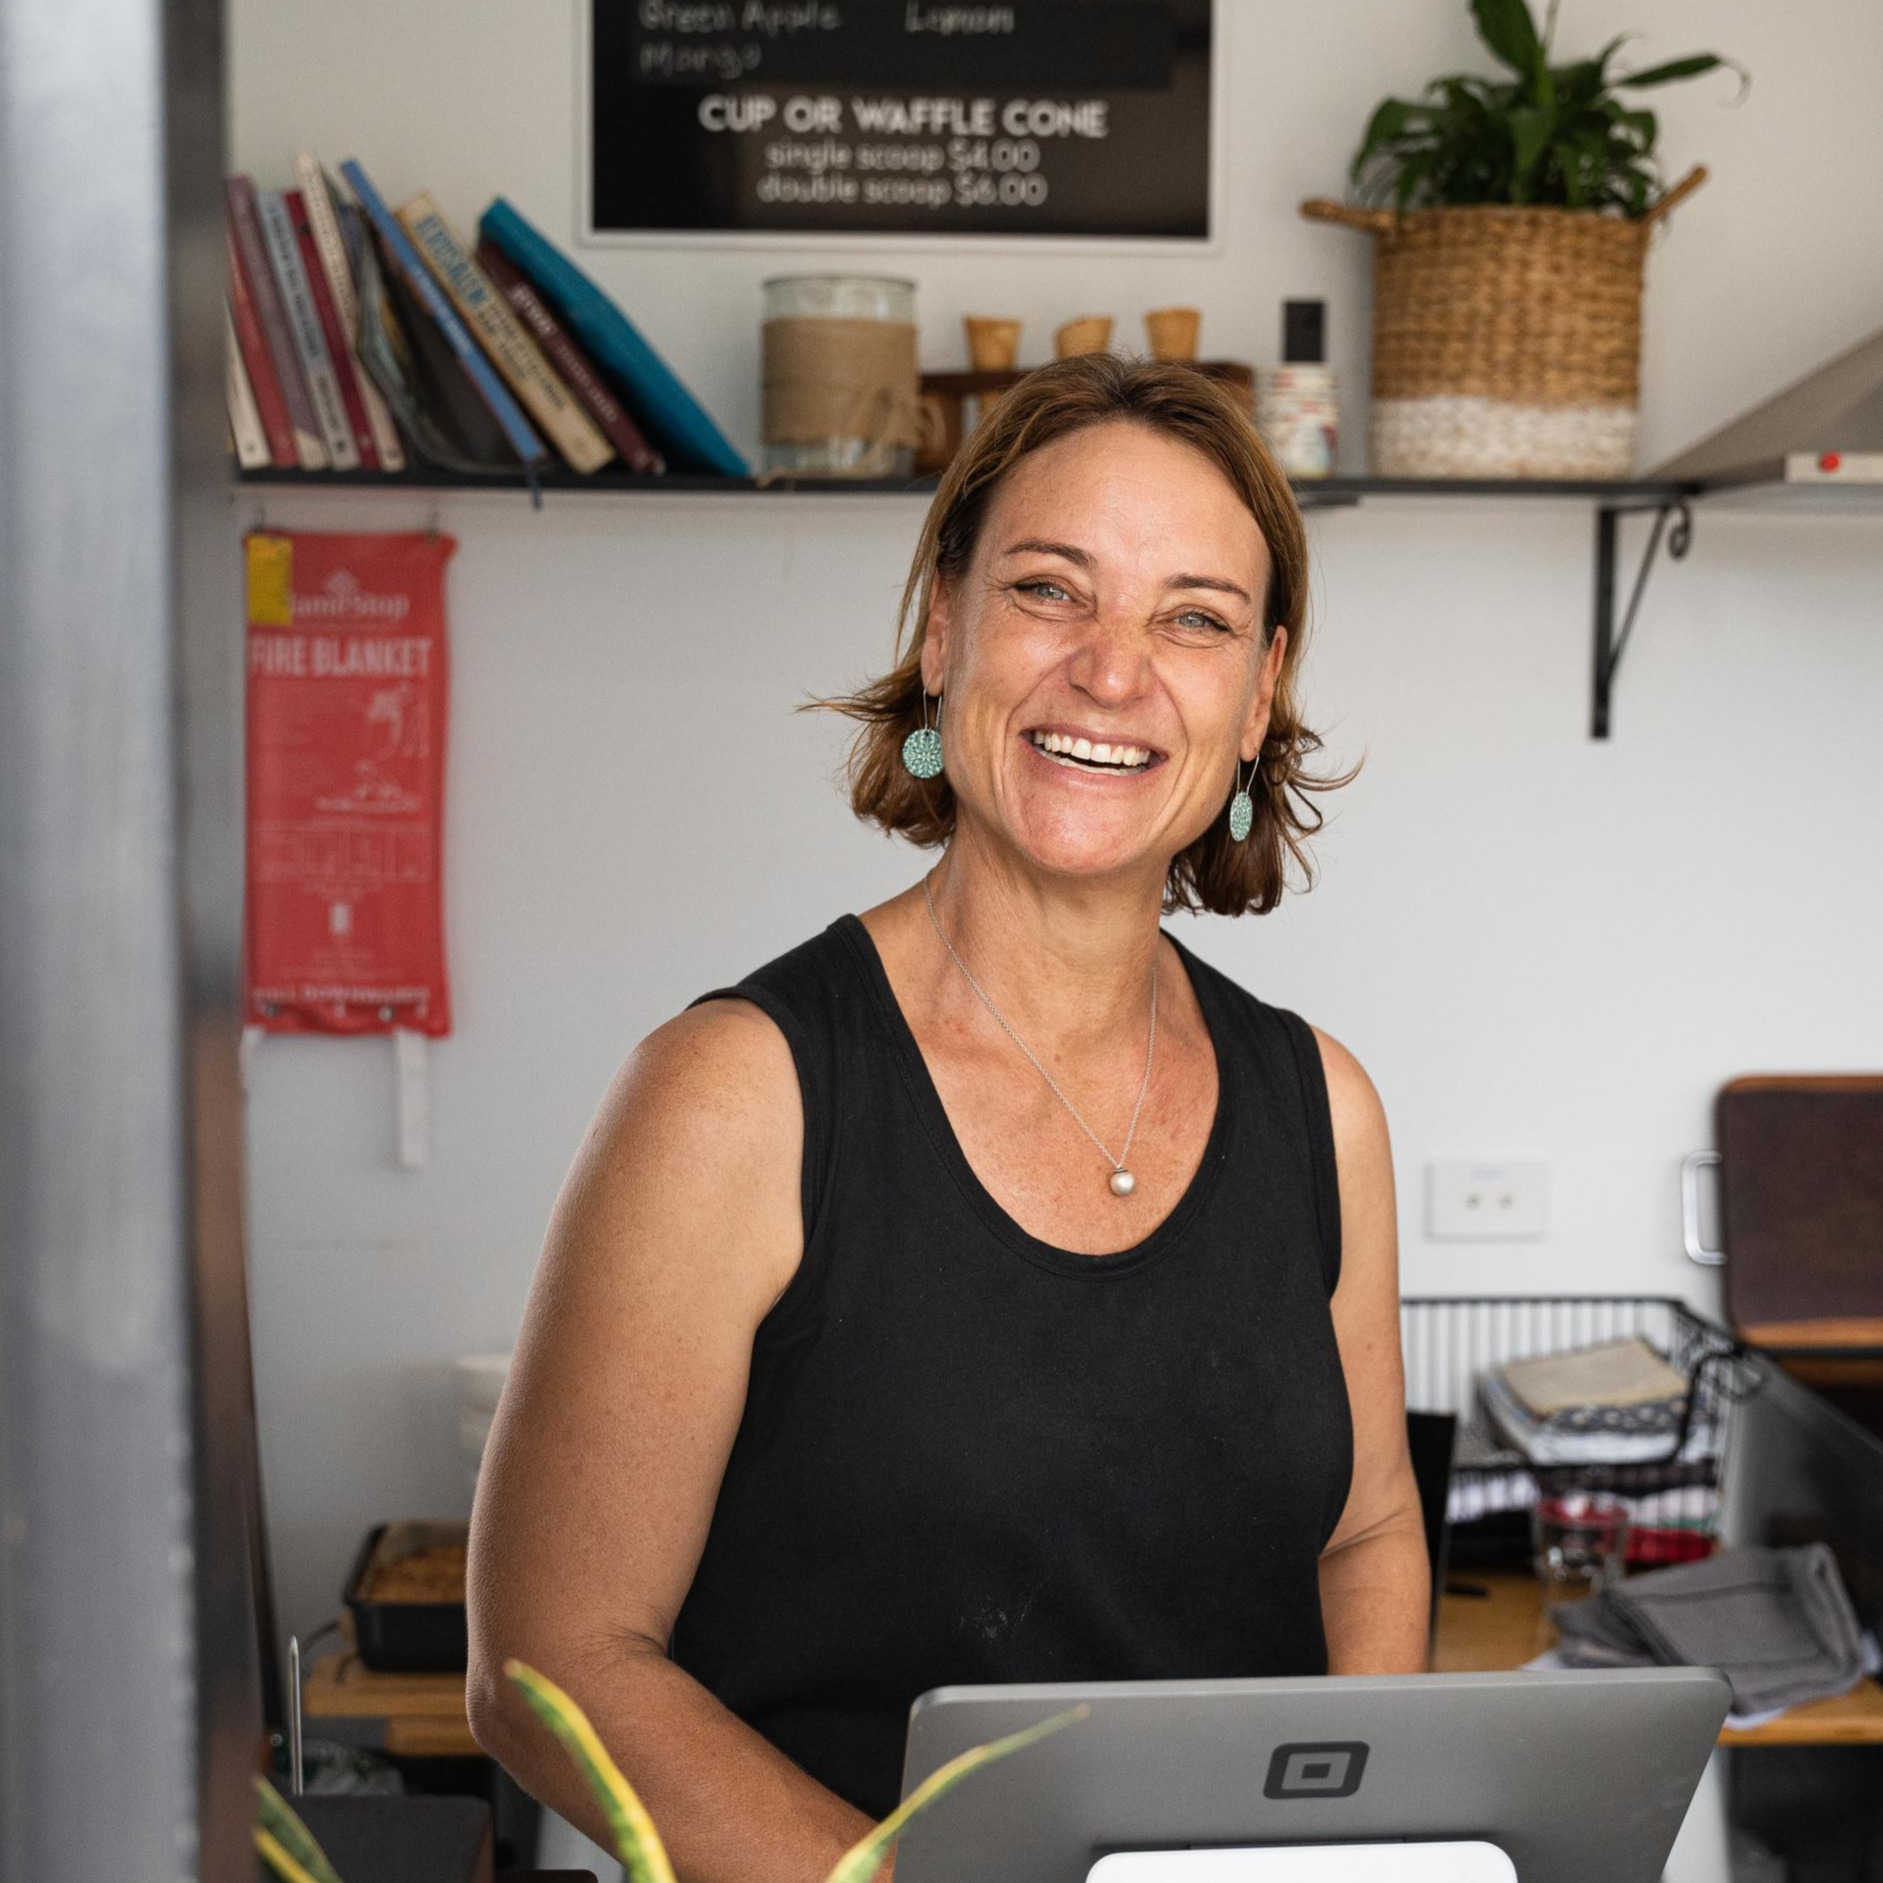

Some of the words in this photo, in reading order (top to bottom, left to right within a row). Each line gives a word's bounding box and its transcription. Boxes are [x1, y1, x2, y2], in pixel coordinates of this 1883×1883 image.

[698, 95, 775, 133] CUP
[784, 97, 842, 134] OR
[852, 98, 996, 136] WAFFLE
[1003, 99, 1107, 138] CONE
[765, 138, 851, 174] single
[855, 143, 945, 174] scoop
[757, 173, 859, 204] double
[862, 178, 951, 209] scoop
[251, 635, 305, 674] FIRE
[312, 635, 432, 677] BLANKET
